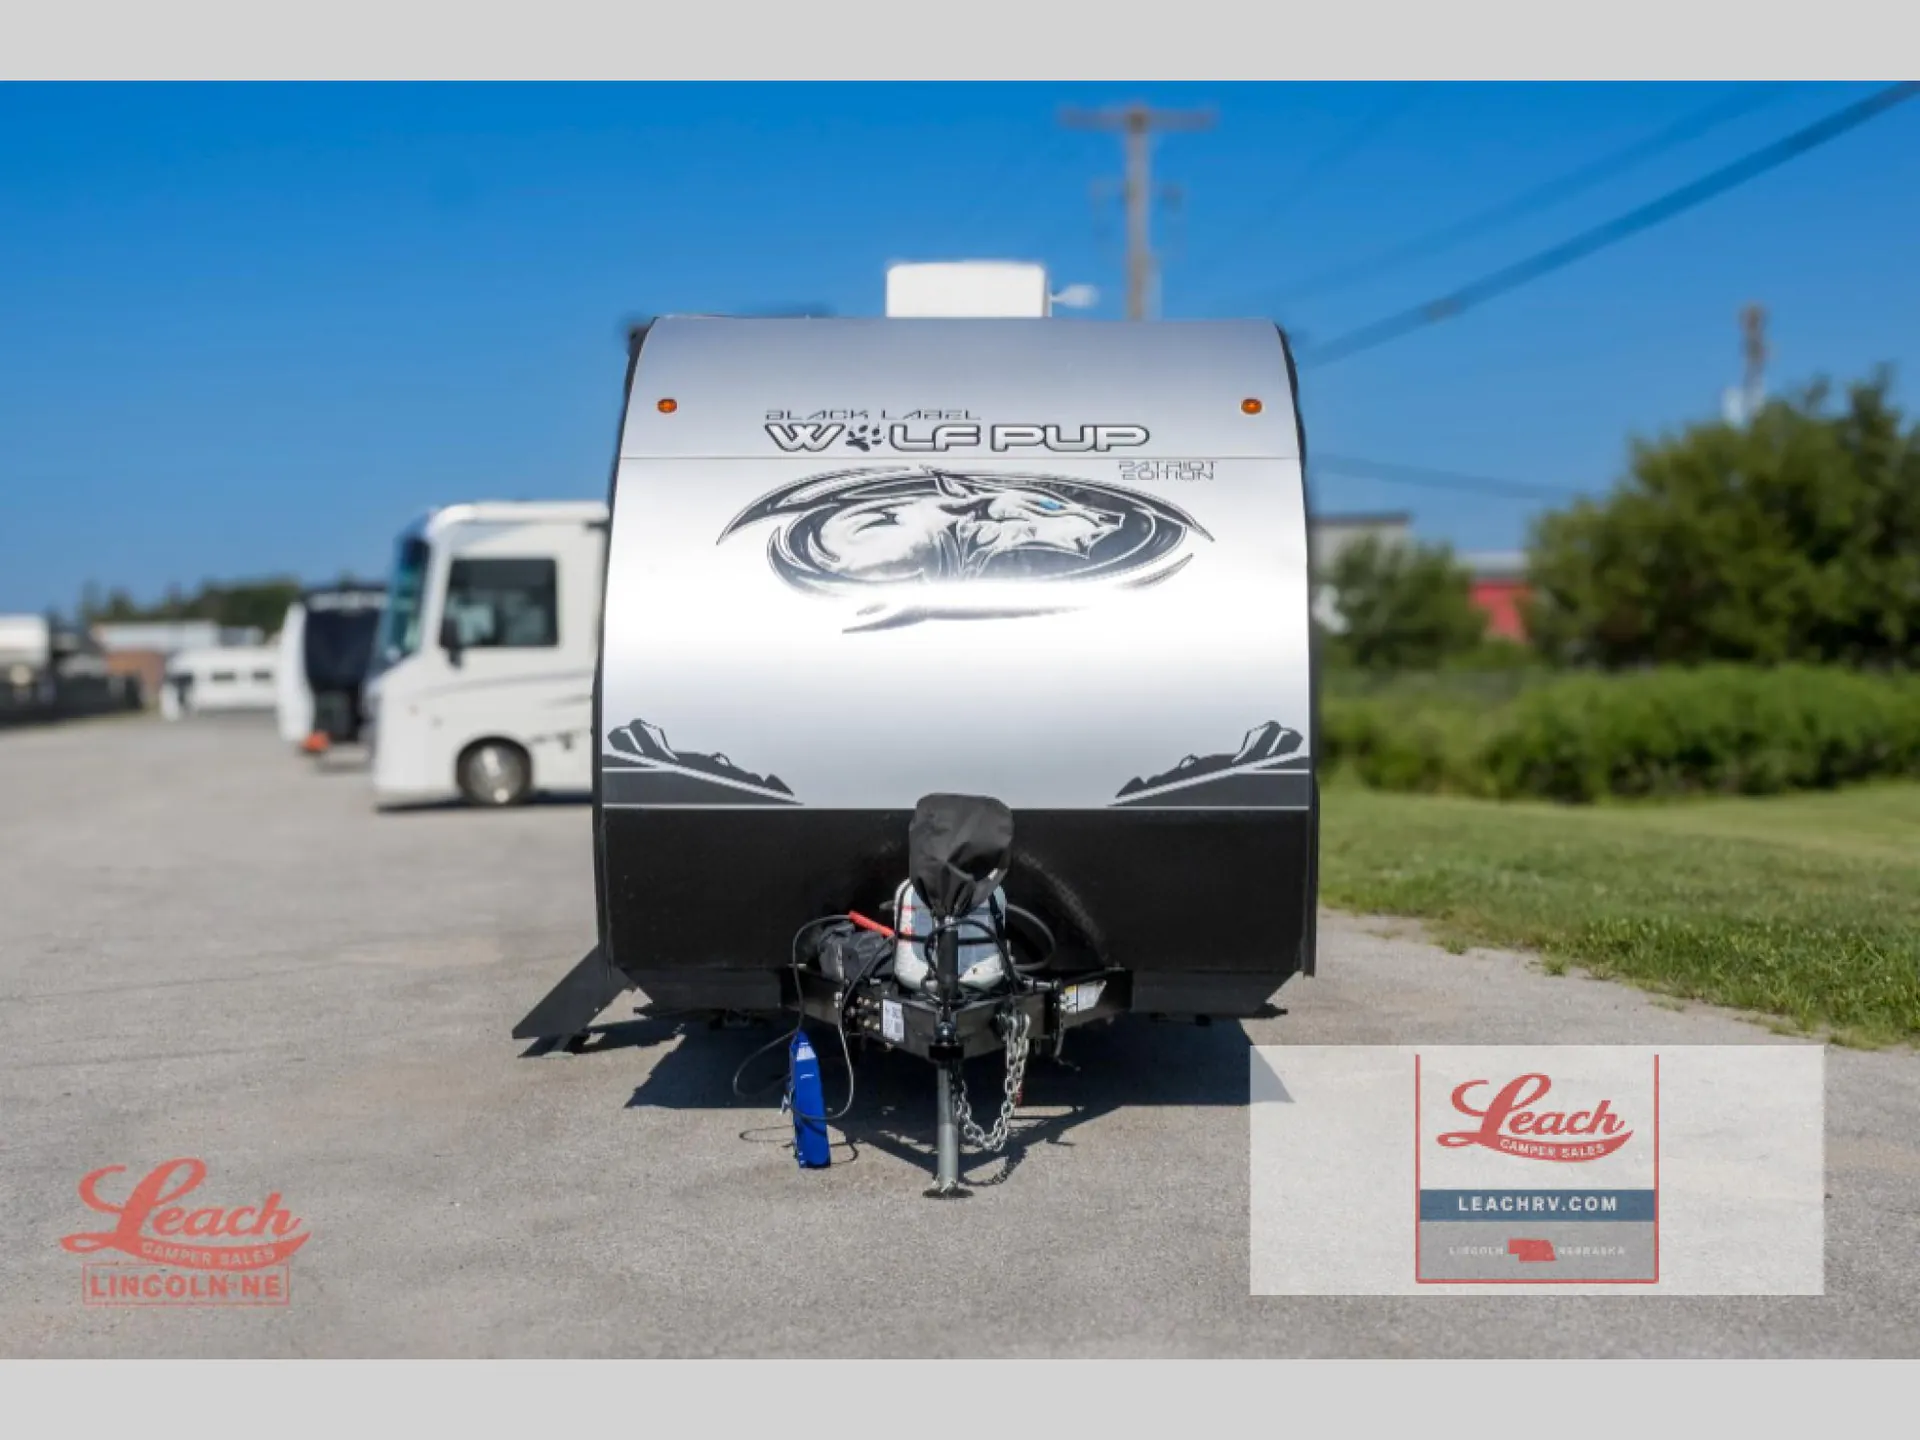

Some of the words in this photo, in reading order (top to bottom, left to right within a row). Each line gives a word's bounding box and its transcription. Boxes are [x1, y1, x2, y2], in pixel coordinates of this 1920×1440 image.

[766, 409, 869, 421] BLACK
[881, 409, 981, 421] LABEL
[764, 423, 981, 452] WLF
[990, 424, 1150, 452] PUP
